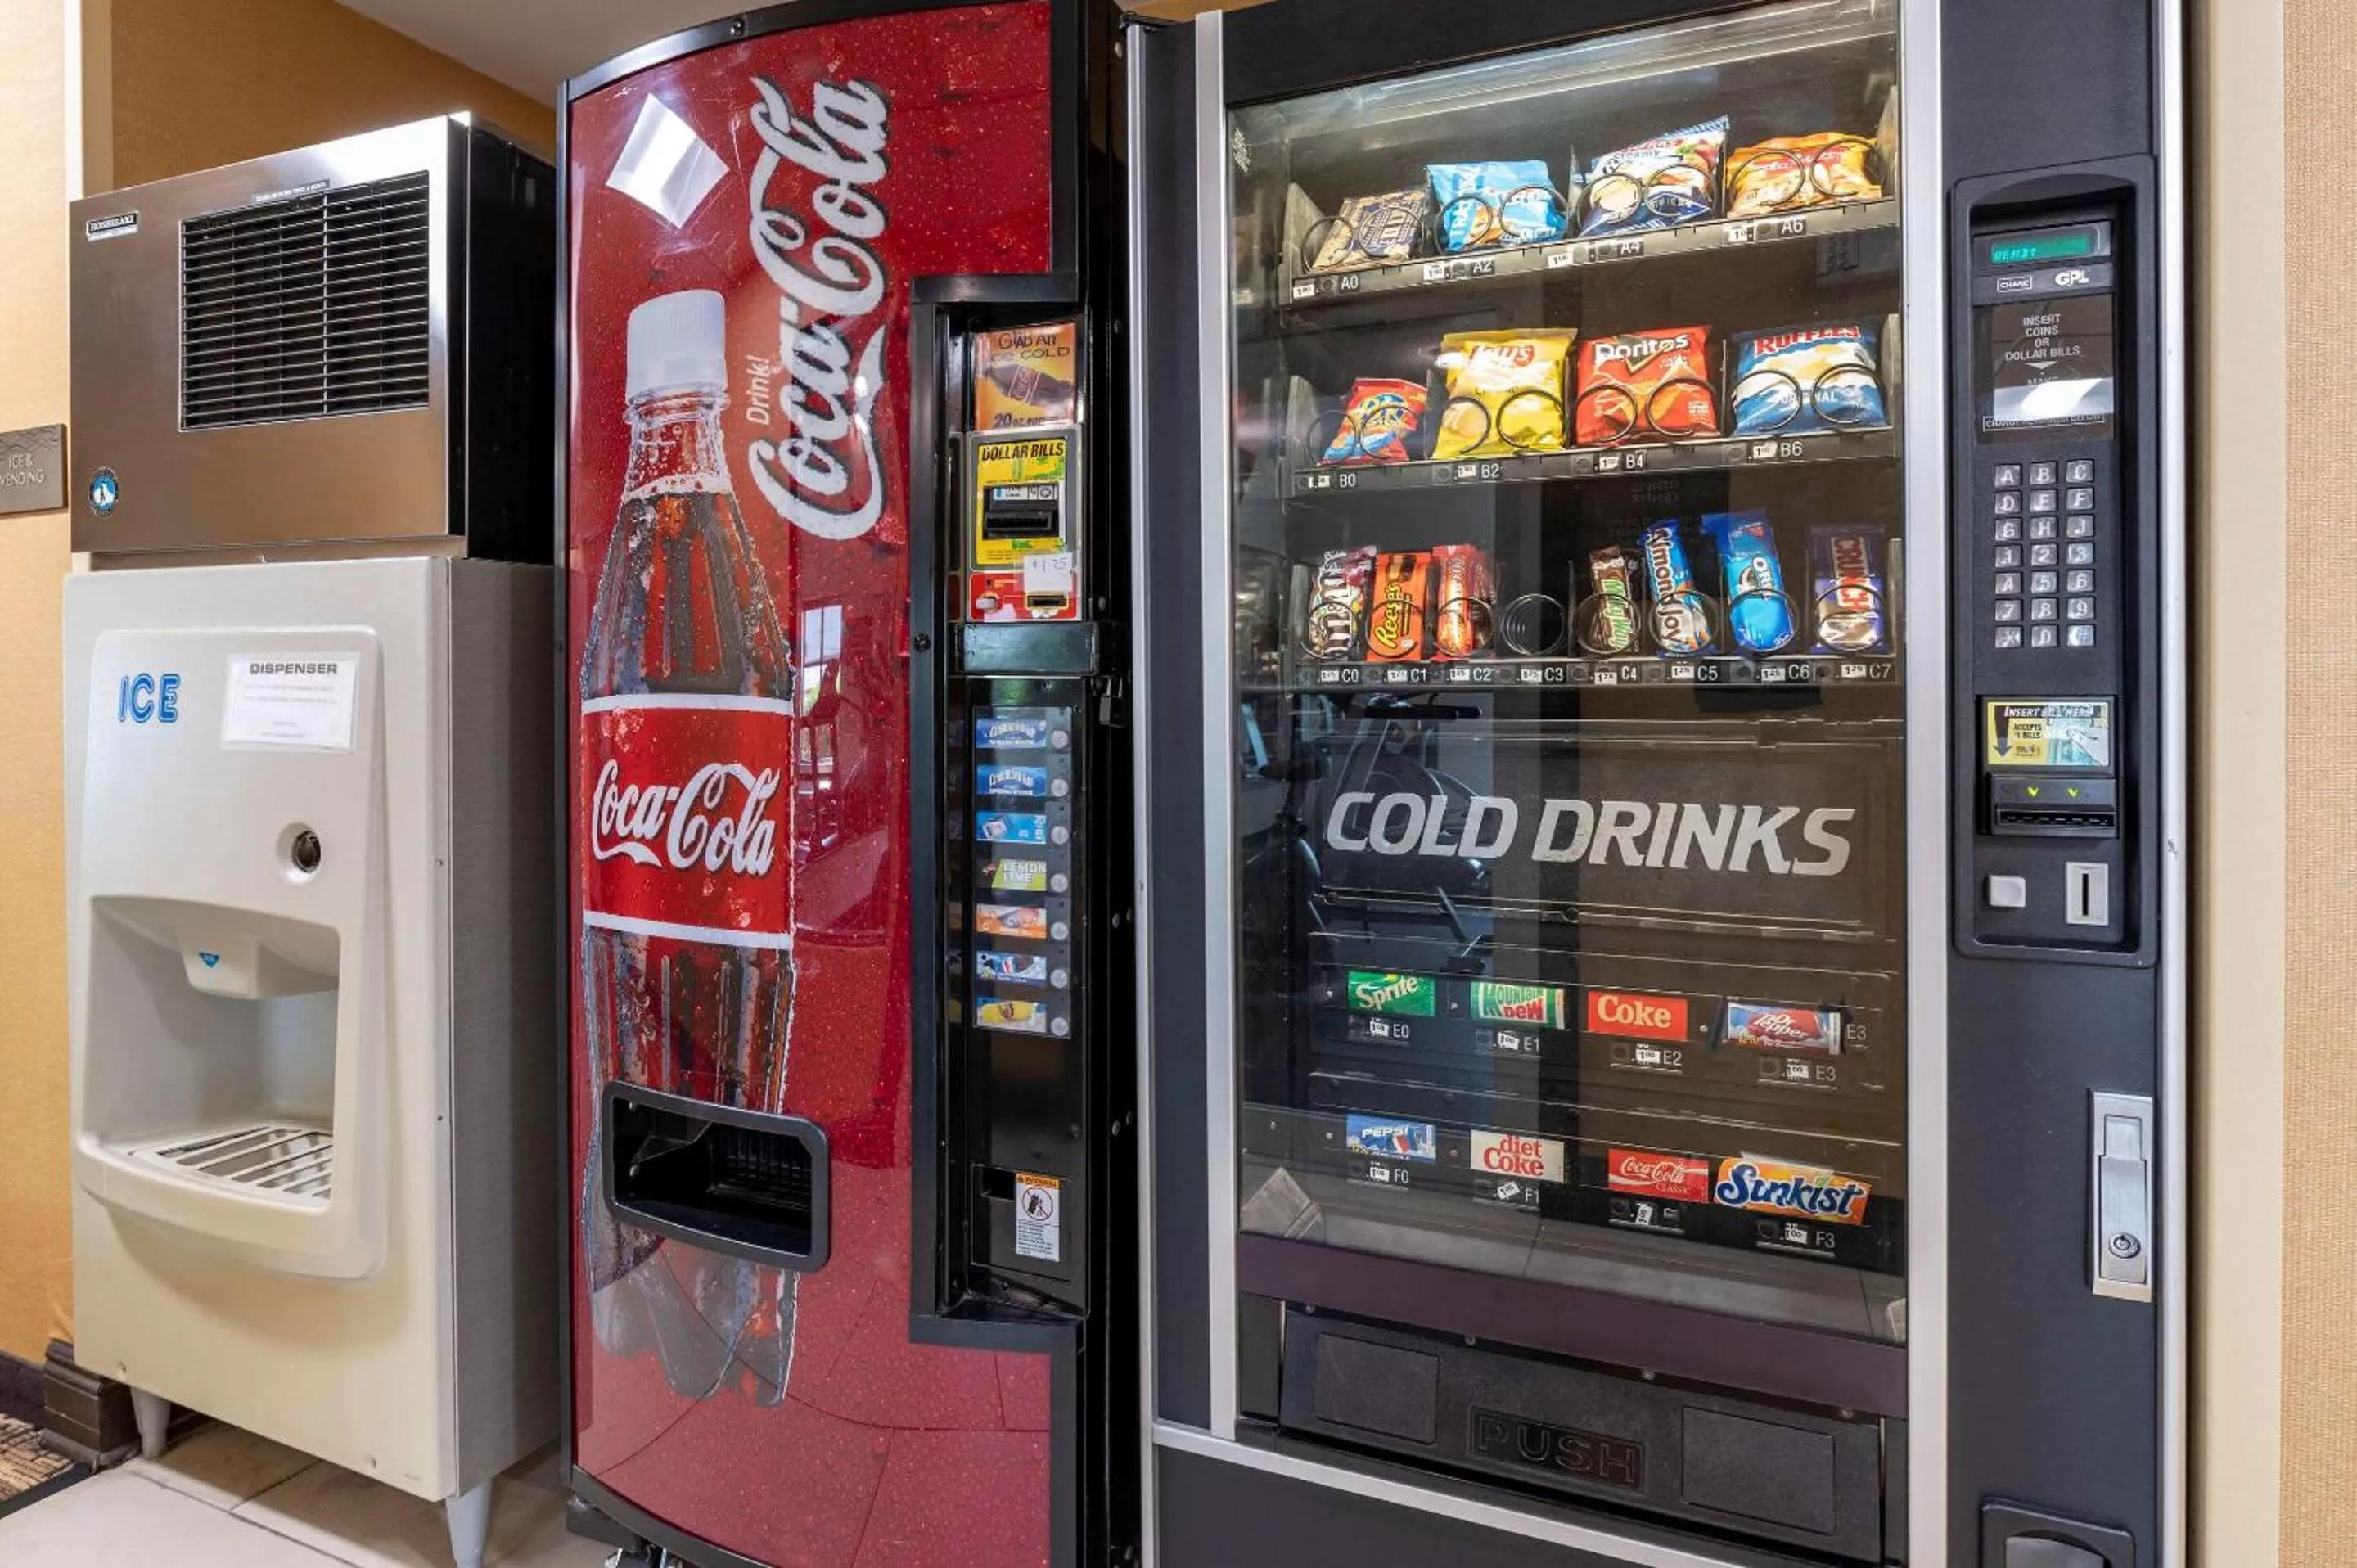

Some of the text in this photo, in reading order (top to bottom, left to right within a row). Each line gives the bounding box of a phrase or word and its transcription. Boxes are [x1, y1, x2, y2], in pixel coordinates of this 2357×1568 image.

[1782, 219, 1803, 234] A6
[1620, 242, 1640, 255] A4
[1473, 260, 1492, 273] A2
[1341, 276, 1359, 291] A0
[2055, 270, 2090, 286] GPL
[748, 76, 890, 541] Coca-Cola
[2022, 313, 2062, 327] INSERT
[2025, 325, 2059, 337] COINS
[1754, 326, 1861, 355] RUFFLES
[2034, 337, 2050, 348] OR
[1020, 346, 1070, 360] COLD
[1595, 334, 1690, 365] Doritos
[2005, 345, 2080, 362] DOLLAR BILLS
[746, 354, 772, 426] Drink!
[982, 440, 1064, 462] DOLLAR BILLS
[1780, 440, 1803, 457] B6
[9, 454, 24, 469] ICE
[1625, 451, 1643, 469] B4
[1480, 463, 1500, 478] B2
[1339, 473, 1356, 488] B0
[1834, 538, 1871, 614] CRUNCH
[249, 662, 338, 675] DISPENSER
[1341, 669, 1359, 683] C0
[1410, 668, 1426, 682] C1
[1473, 667, 1493, 682] C2
[1544, 667, 1564, 682] C3
[1621, 665, 1638, 681] C4
[1697, 665, 1719, 681] C5
[1789, 664, 1811, 679] C6
[1869, 664, 1892, 679] C7
[119, 673, 182, 724] ICE
[2004, 706, 2039, 718] INSERT
[592, 759, 781, 876] Coca-Cola
[1326, 791, 1856, 877] COLD DRINKS
[1355, 975, 1420, 1011] Sprite
[1598, 994, 1672, 1029] Coke
[1393, 1024, 1409, 1039] E0
[1846, 1024, 1867, 1041] E3
[1523, 1036, 1539, 1052] E1
[1663, 1050, 1683, 1066] E2
[1815, 1065, 1836, 1082] E3
[1361, 1125, 1409, 1139] PEPSI
[1499, 1133, 1543, 1159] diet
[1483, 1147, 1544, 1177] Coke
[1394, 1168, 1409, 1184] F0
[1620, 1156, 1687, 1185] Coca-Cola
[1525, 1187, 1539, 1205] F1
[1716, 1164, 1865, 1216] Sunkist
[1816, 1231, 1836, 1248] F3
[1479, 1413, 1635, 1483] PUSH
